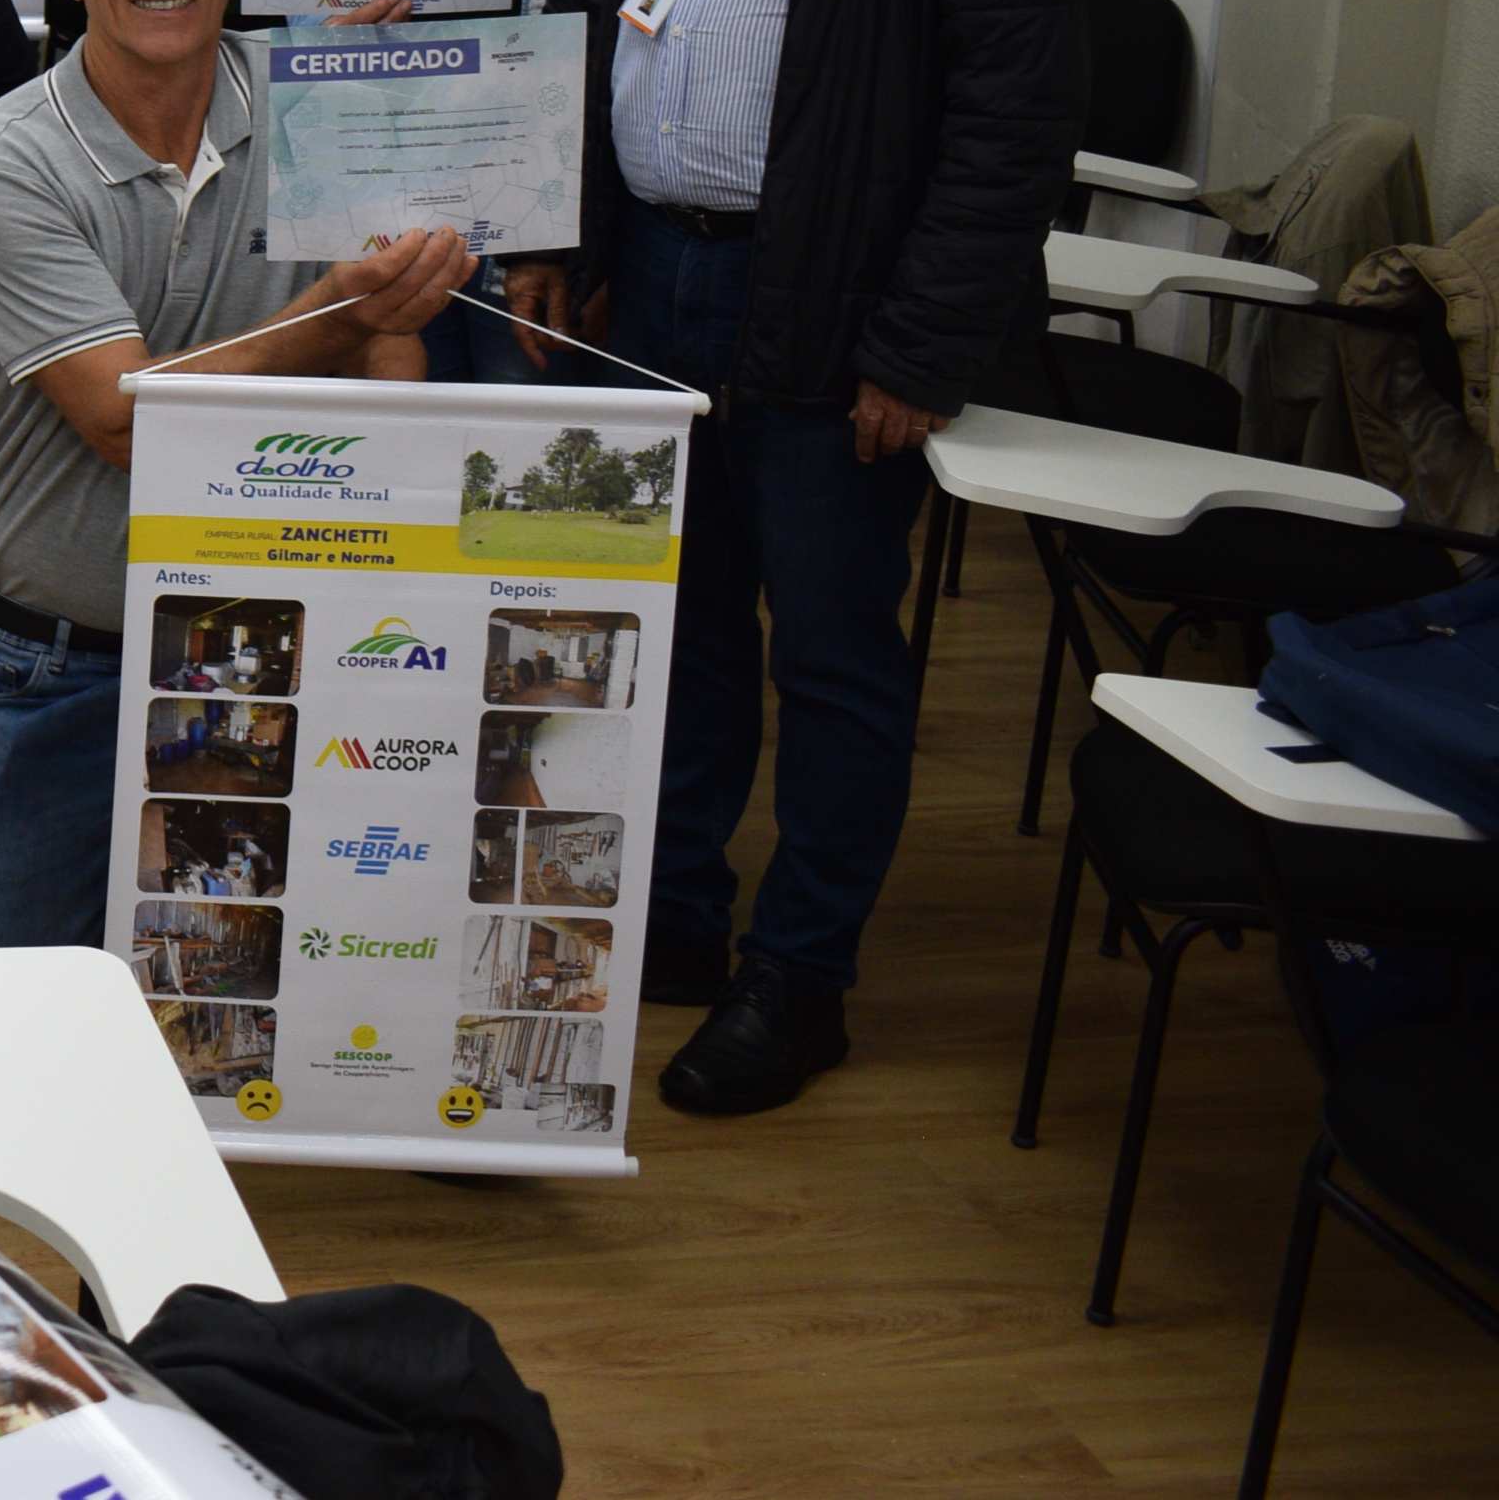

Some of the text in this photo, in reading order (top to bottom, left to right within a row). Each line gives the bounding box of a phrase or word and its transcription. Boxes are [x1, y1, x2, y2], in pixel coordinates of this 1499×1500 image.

[290, 47, 464, 76] CERTIFICADO
[206, 482, 390, 502] Na Qualidade Rural
[280, 526, 389, 545] ZANCHETTI
[267, 547, 395, 567] Gilmar e Norma
[155, 568, 212, 587] Antes:
[489, 580, 558, 600] Depois:
[337, 645, 447, 671] COOPER A1
[373, 738, 460, 757] AURORA
[372, 754, 431, 772] COOP
[325, 839, 431, 862] SEBRAE
[337, 934, 438, 961] Sicredi
[333, 1051, 393, 1061] SESCOOP
